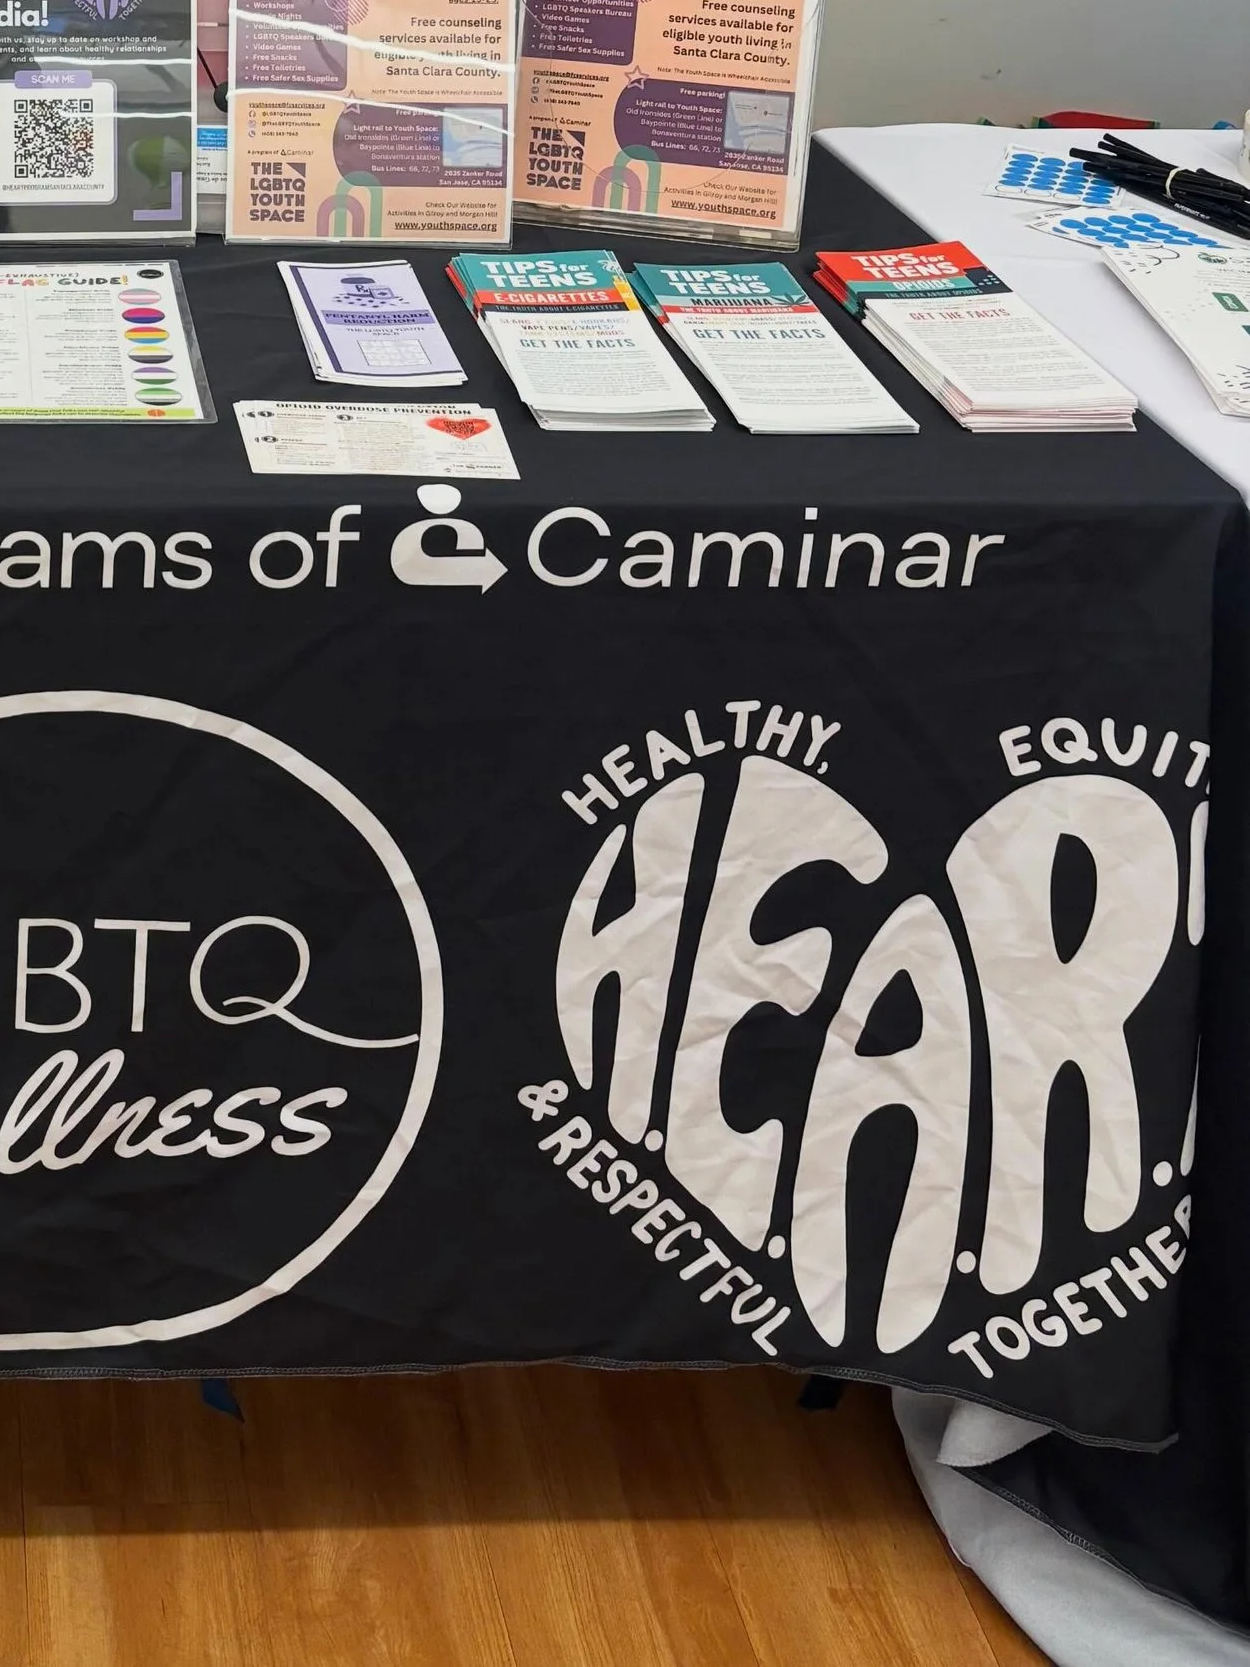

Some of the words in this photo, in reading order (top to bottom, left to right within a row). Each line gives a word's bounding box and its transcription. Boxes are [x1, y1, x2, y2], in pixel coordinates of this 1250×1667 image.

[702, 0, 728, 11] Free
[730, 2, 795, 18] counseling
[669, 13, 717, 26] services
[719, 16, 774, 31] available
[776, 22, 794, 33] for
[662, 28, 705, 42] eligible
[708, 32, 743, 46] youth
[746, 34, 778, 50] living
[673, 45, 708, 57] Santa
[710, 48, 740, 60] Clara
[744, 52, 790, 66] County.
[31, 75, 59, 83] SCAN
[62, 75, 75, 83] ME
[531, 126, 563, 142] THE
[529, 143, 584, 161] LGBTQ
[529, 158, 583, 174] YOUTH
[526, 174, 582, 191] SPACE
[671, 198, 776, 220] www.youthspace.org
[394, 221, 497, 233] www.youthspace.org
[480, 260, 558, 274] TIPS
[559, 264, 588, 272] for
[852, 253, 920, 267] TIPS
[919, 255, 945, 263] for
[660, 270, 732, 282] TIPS
[863, 262, 960, 279] TEENS
[58, 276, 129, 286] GUIDE!
[487, 272, 598, 287] TEENS
[892, 279, 955, 290] OPIOIDS
[669, 282, 771, 294] TEENS
[493, 291, 609, 303] E-CIGARETTES
[691, 298, 773, 306] MARIJUANA
[693, 329, 725, 339] GET
[730, 329, 766, 339] THE
[770, 329, 826, 339] FACTS
[249, 504, 362, 590] of
[526, 505, 1005, 591] Caminar
[561, 700, 842, 826] HEALTHY,
[999, 717, 1210, 795] EQUIT
[517, 1078, 560, 1120] &
[538, 1115, 790, 1357] RESPECTFUL
